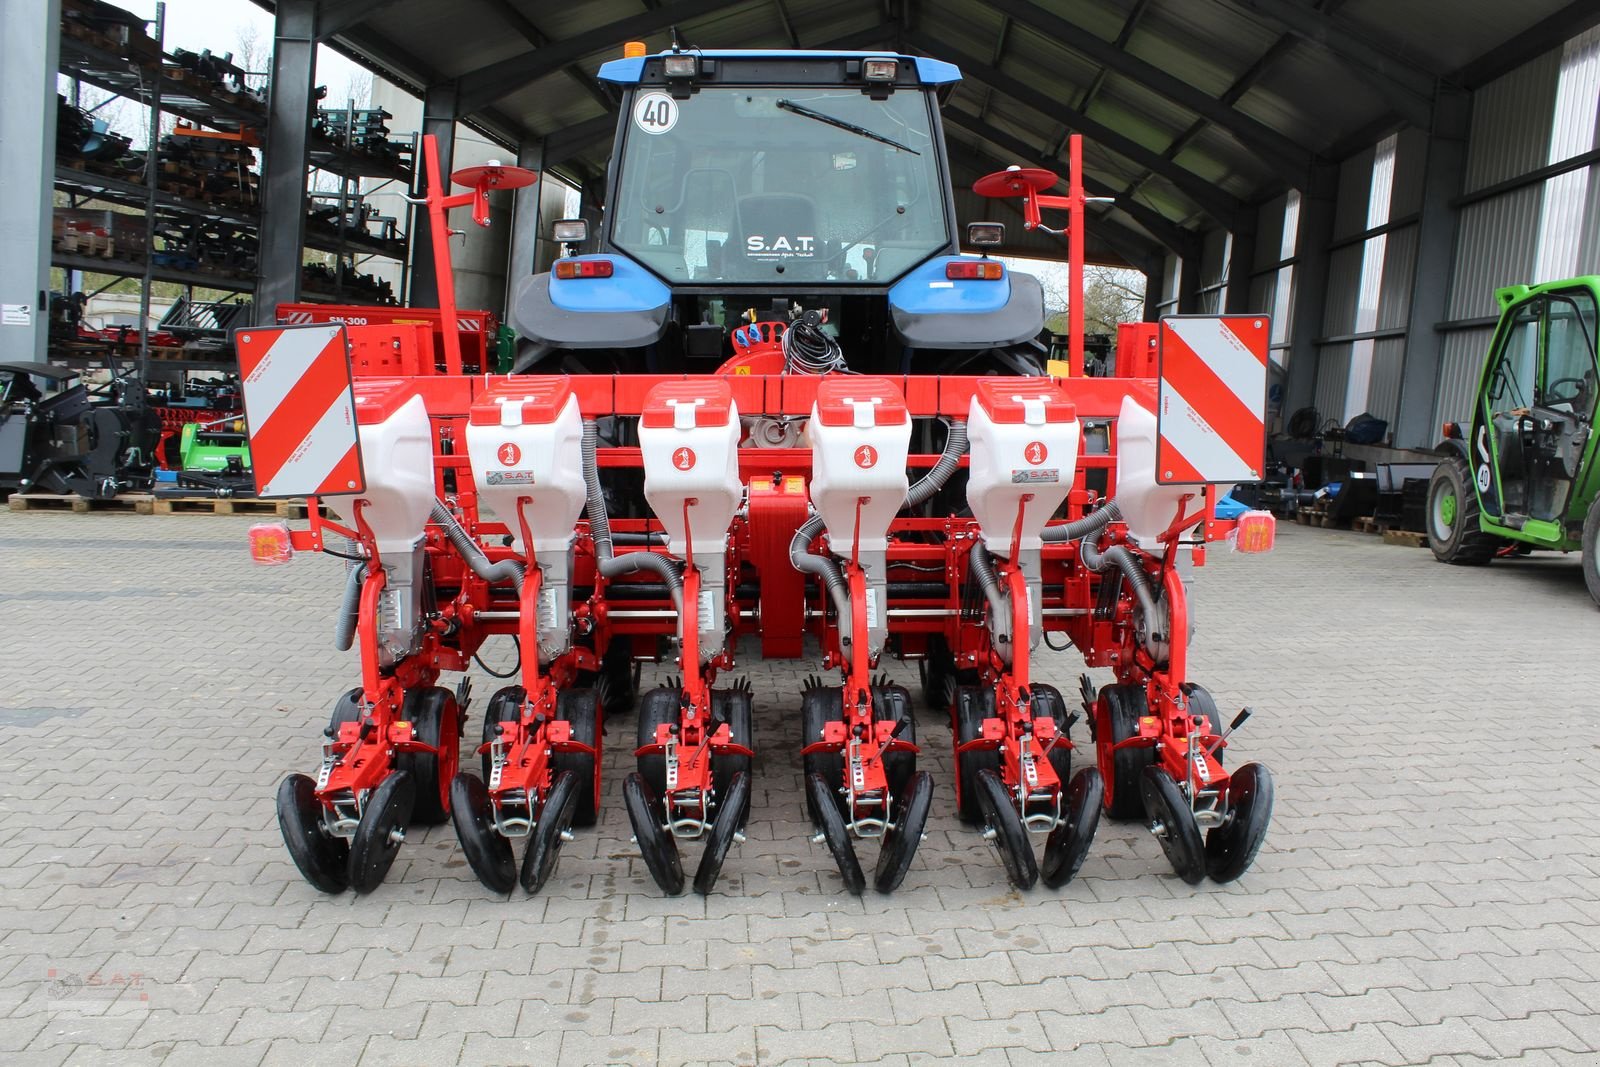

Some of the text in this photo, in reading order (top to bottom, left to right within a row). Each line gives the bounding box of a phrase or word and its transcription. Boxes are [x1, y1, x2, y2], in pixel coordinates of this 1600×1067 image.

[643, 100, 670, 126] 40
[747, 236, 814, 251] S.A.T.
[1480, 470, 1489, 487] 40
